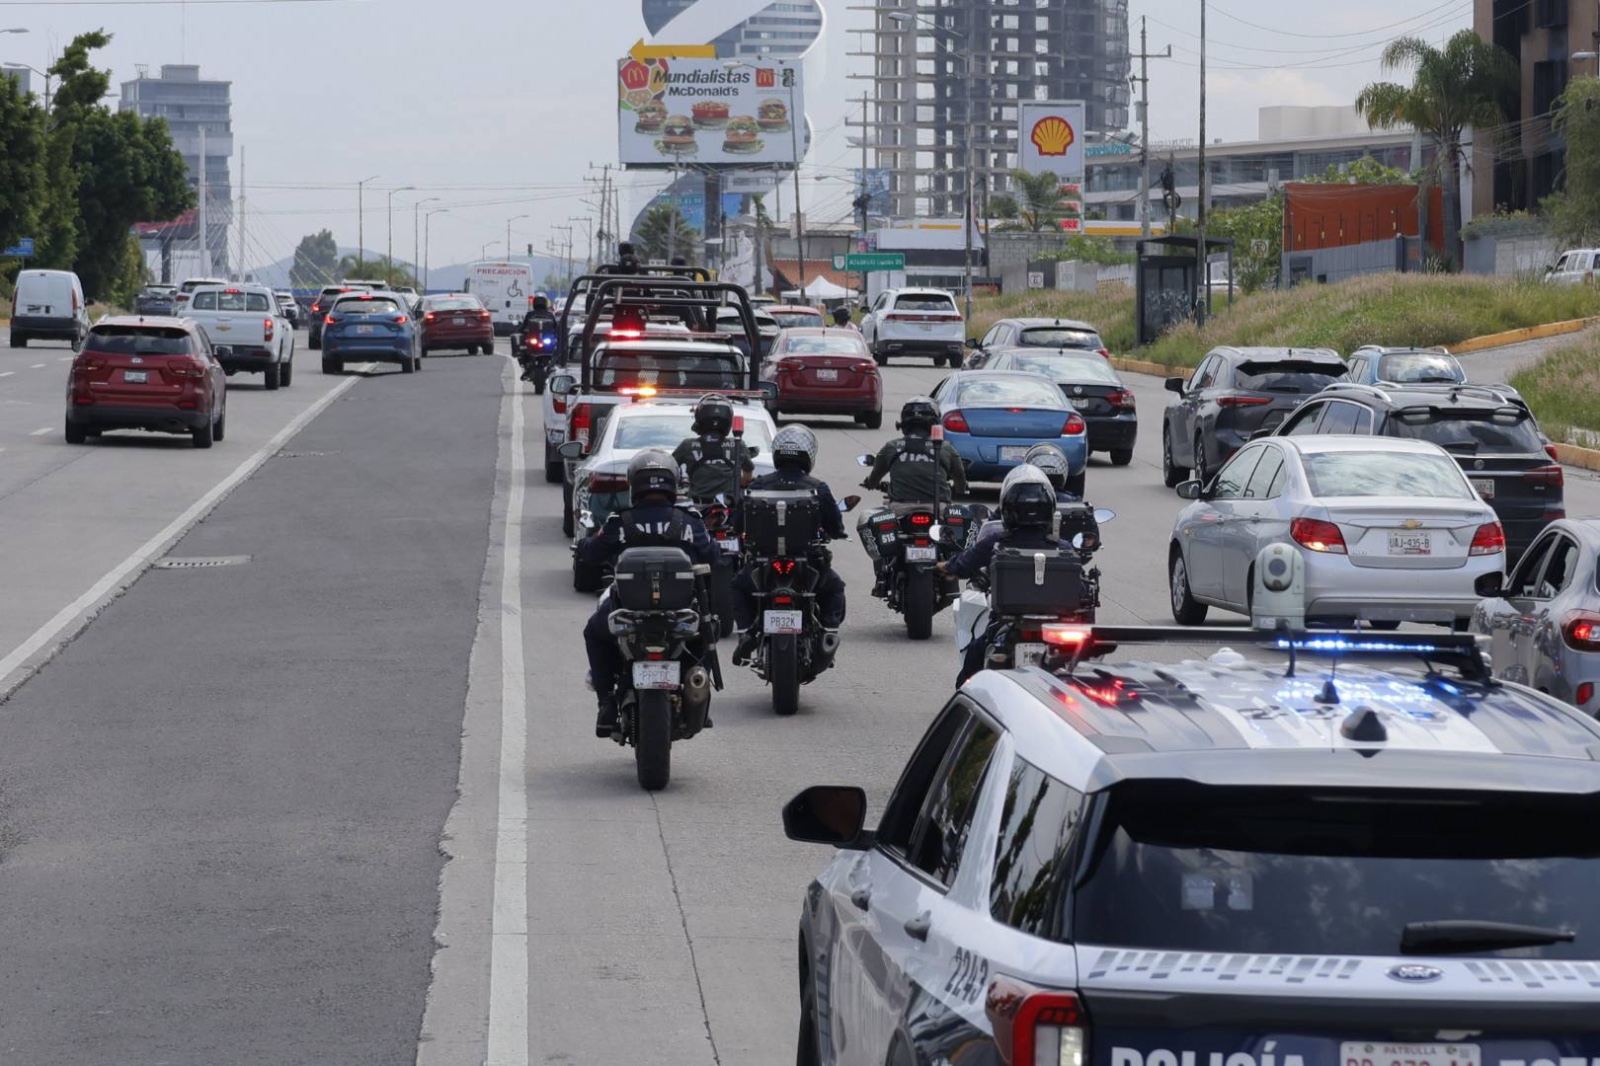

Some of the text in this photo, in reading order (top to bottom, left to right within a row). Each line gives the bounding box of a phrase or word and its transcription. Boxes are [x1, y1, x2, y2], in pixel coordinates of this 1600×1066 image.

[653, 69, 751, 84] Mundialistas
[668, 86, 739, 97] McDonald's
[948, 508, 962, 516] VIAL
[770, 616, 796, 627] PB32K
[944, 946, 989, 1005] 2243
